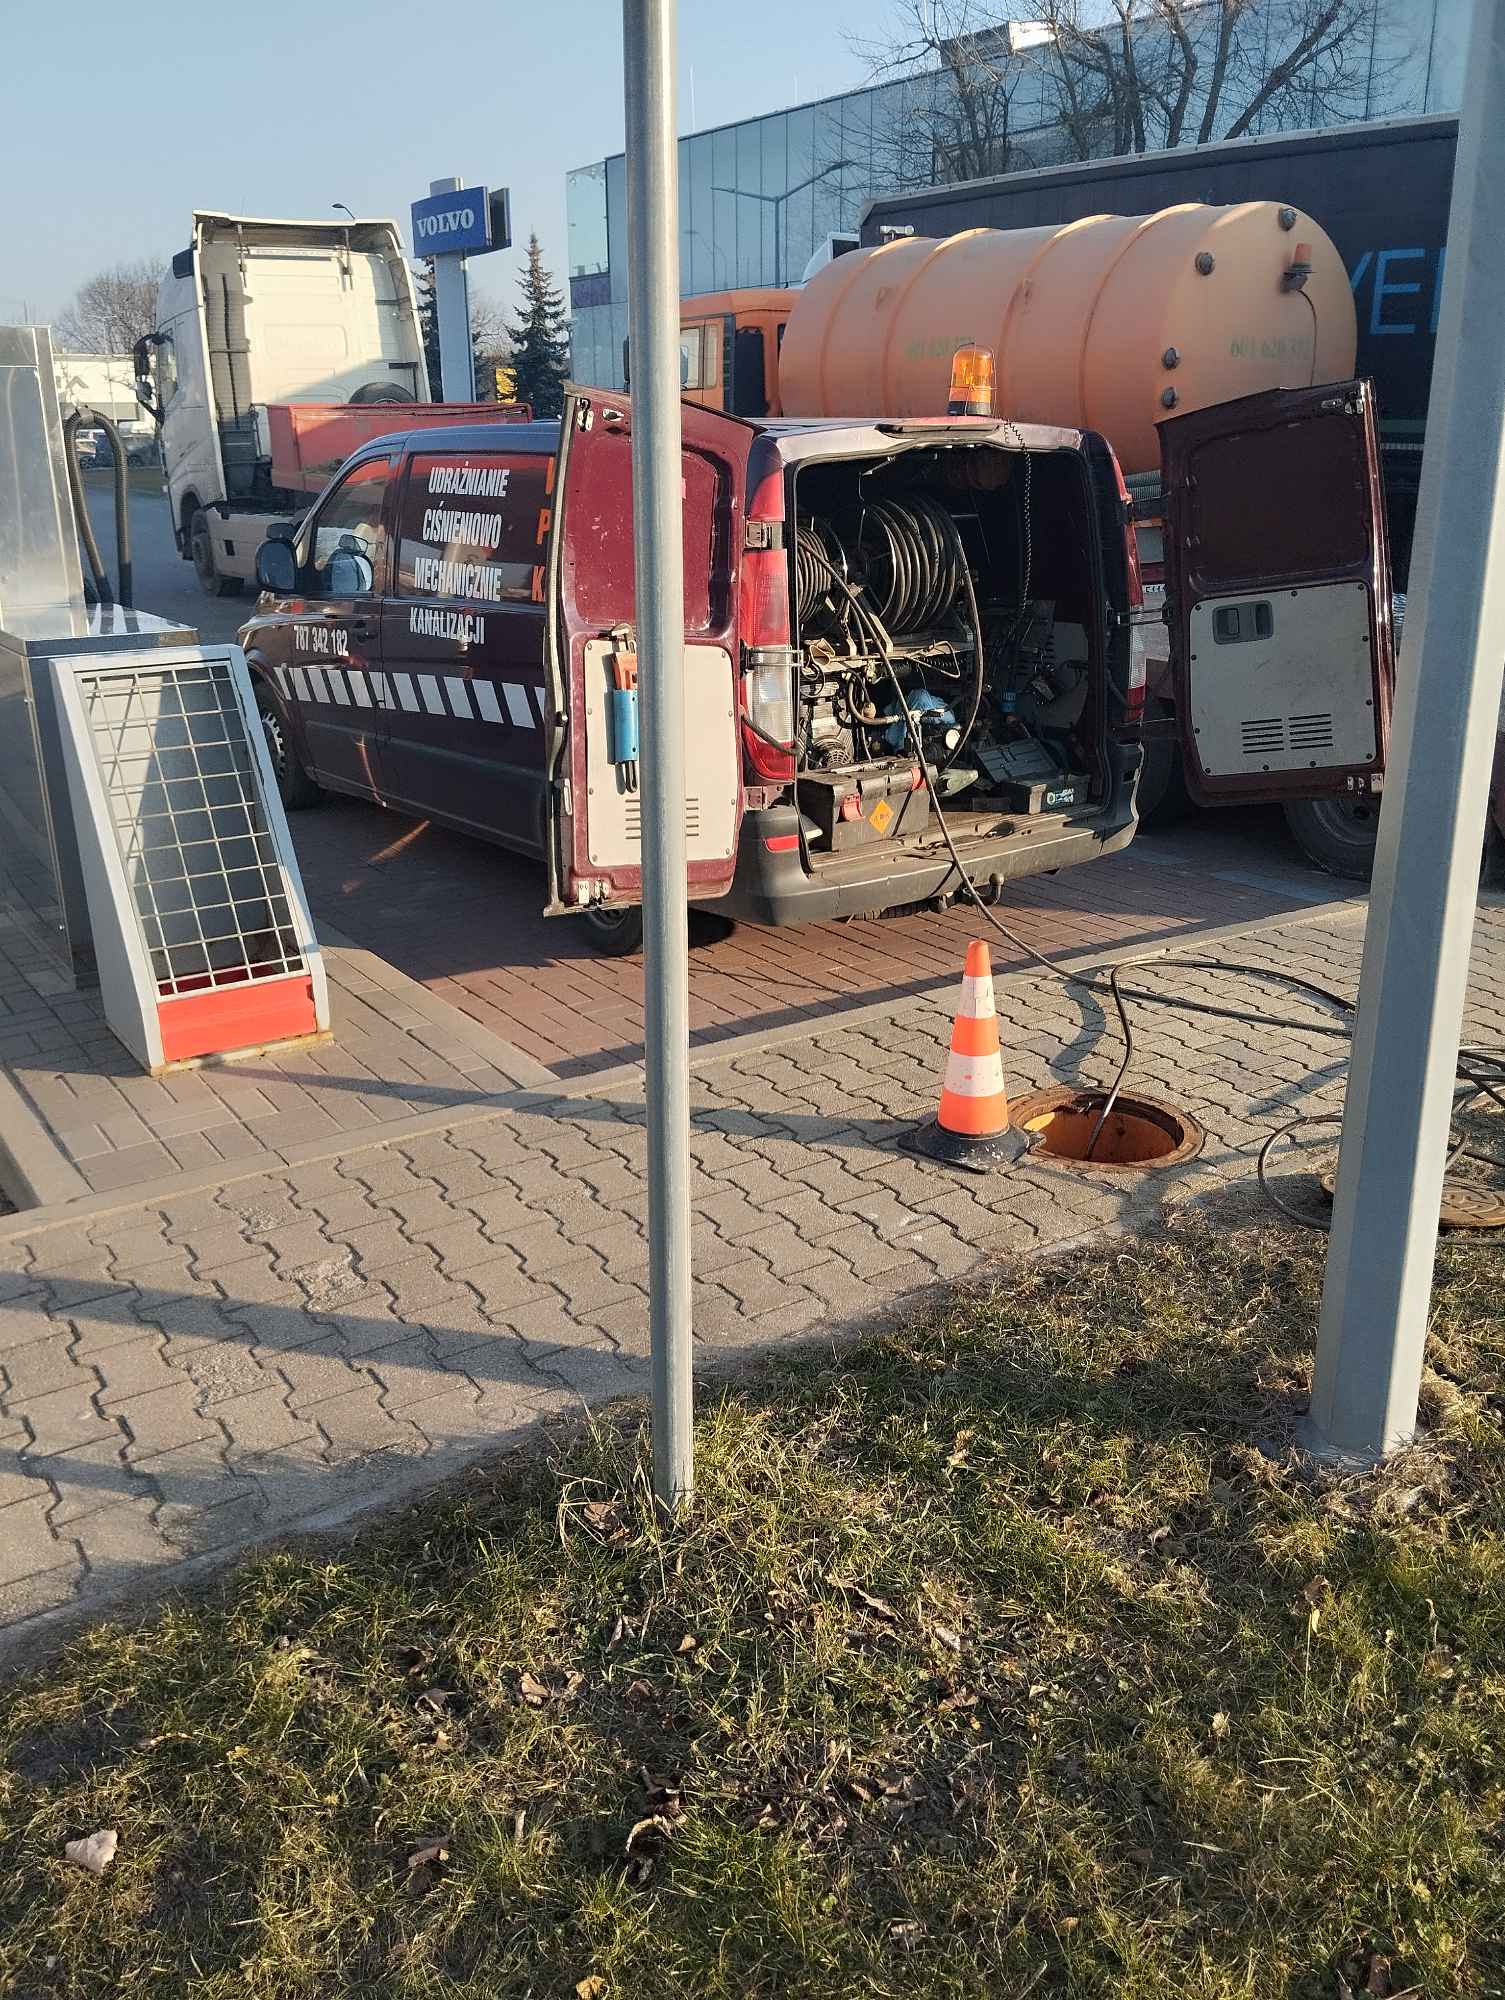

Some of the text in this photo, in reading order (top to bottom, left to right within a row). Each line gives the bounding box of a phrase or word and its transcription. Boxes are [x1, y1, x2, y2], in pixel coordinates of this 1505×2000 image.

[416, 208, 475, 238] VOLVO
[428, 460, 511, 497] UDRAŻNIANIE
[422, 500, 503, 549] CIŚNIENIOWO
[414, 556, 502, 602] MECHANICZNIE
[293, 624, 350, 657] 787 342 182
[409, 606, 486, 645] KANALIZACJI
